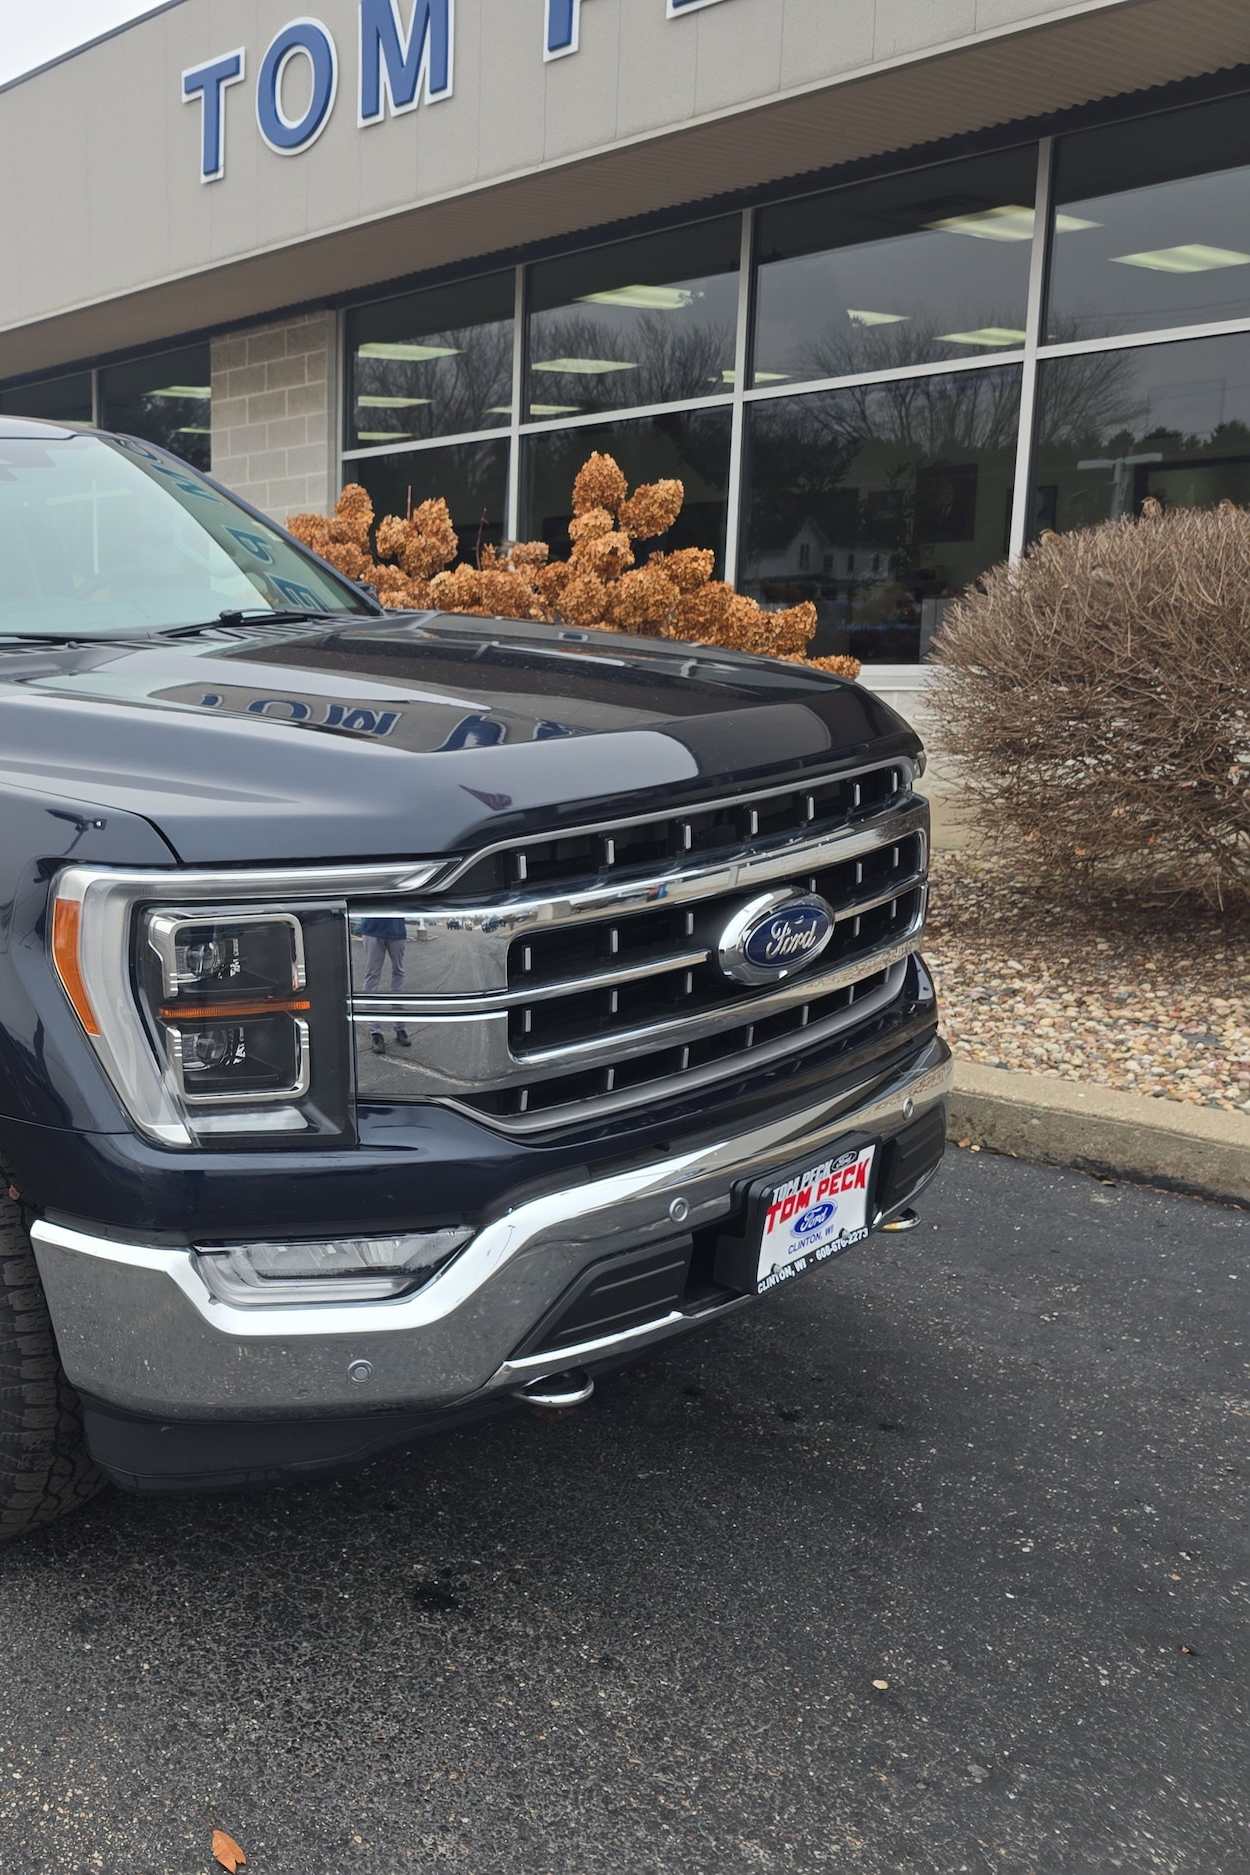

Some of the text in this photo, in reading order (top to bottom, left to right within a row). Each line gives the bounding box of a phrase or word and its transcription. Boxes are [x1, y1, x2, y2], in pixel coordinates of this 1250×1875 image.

[182, 0, 453, 184] TOM
[766, 915, 818, 960] Ford
[766, 1157, 871, 1235] TOM PECK
[771, 1176, 801, 1205] TOM
[800, 1158, 834, 1191] PECK
[787, 1224, 834, 1255] CLINTON, WI
[800, 1206, 830, 1232] Ford
[757, 1265, 796, 1294] CLINTON,
[794, 1257, 807, 1273] WI
